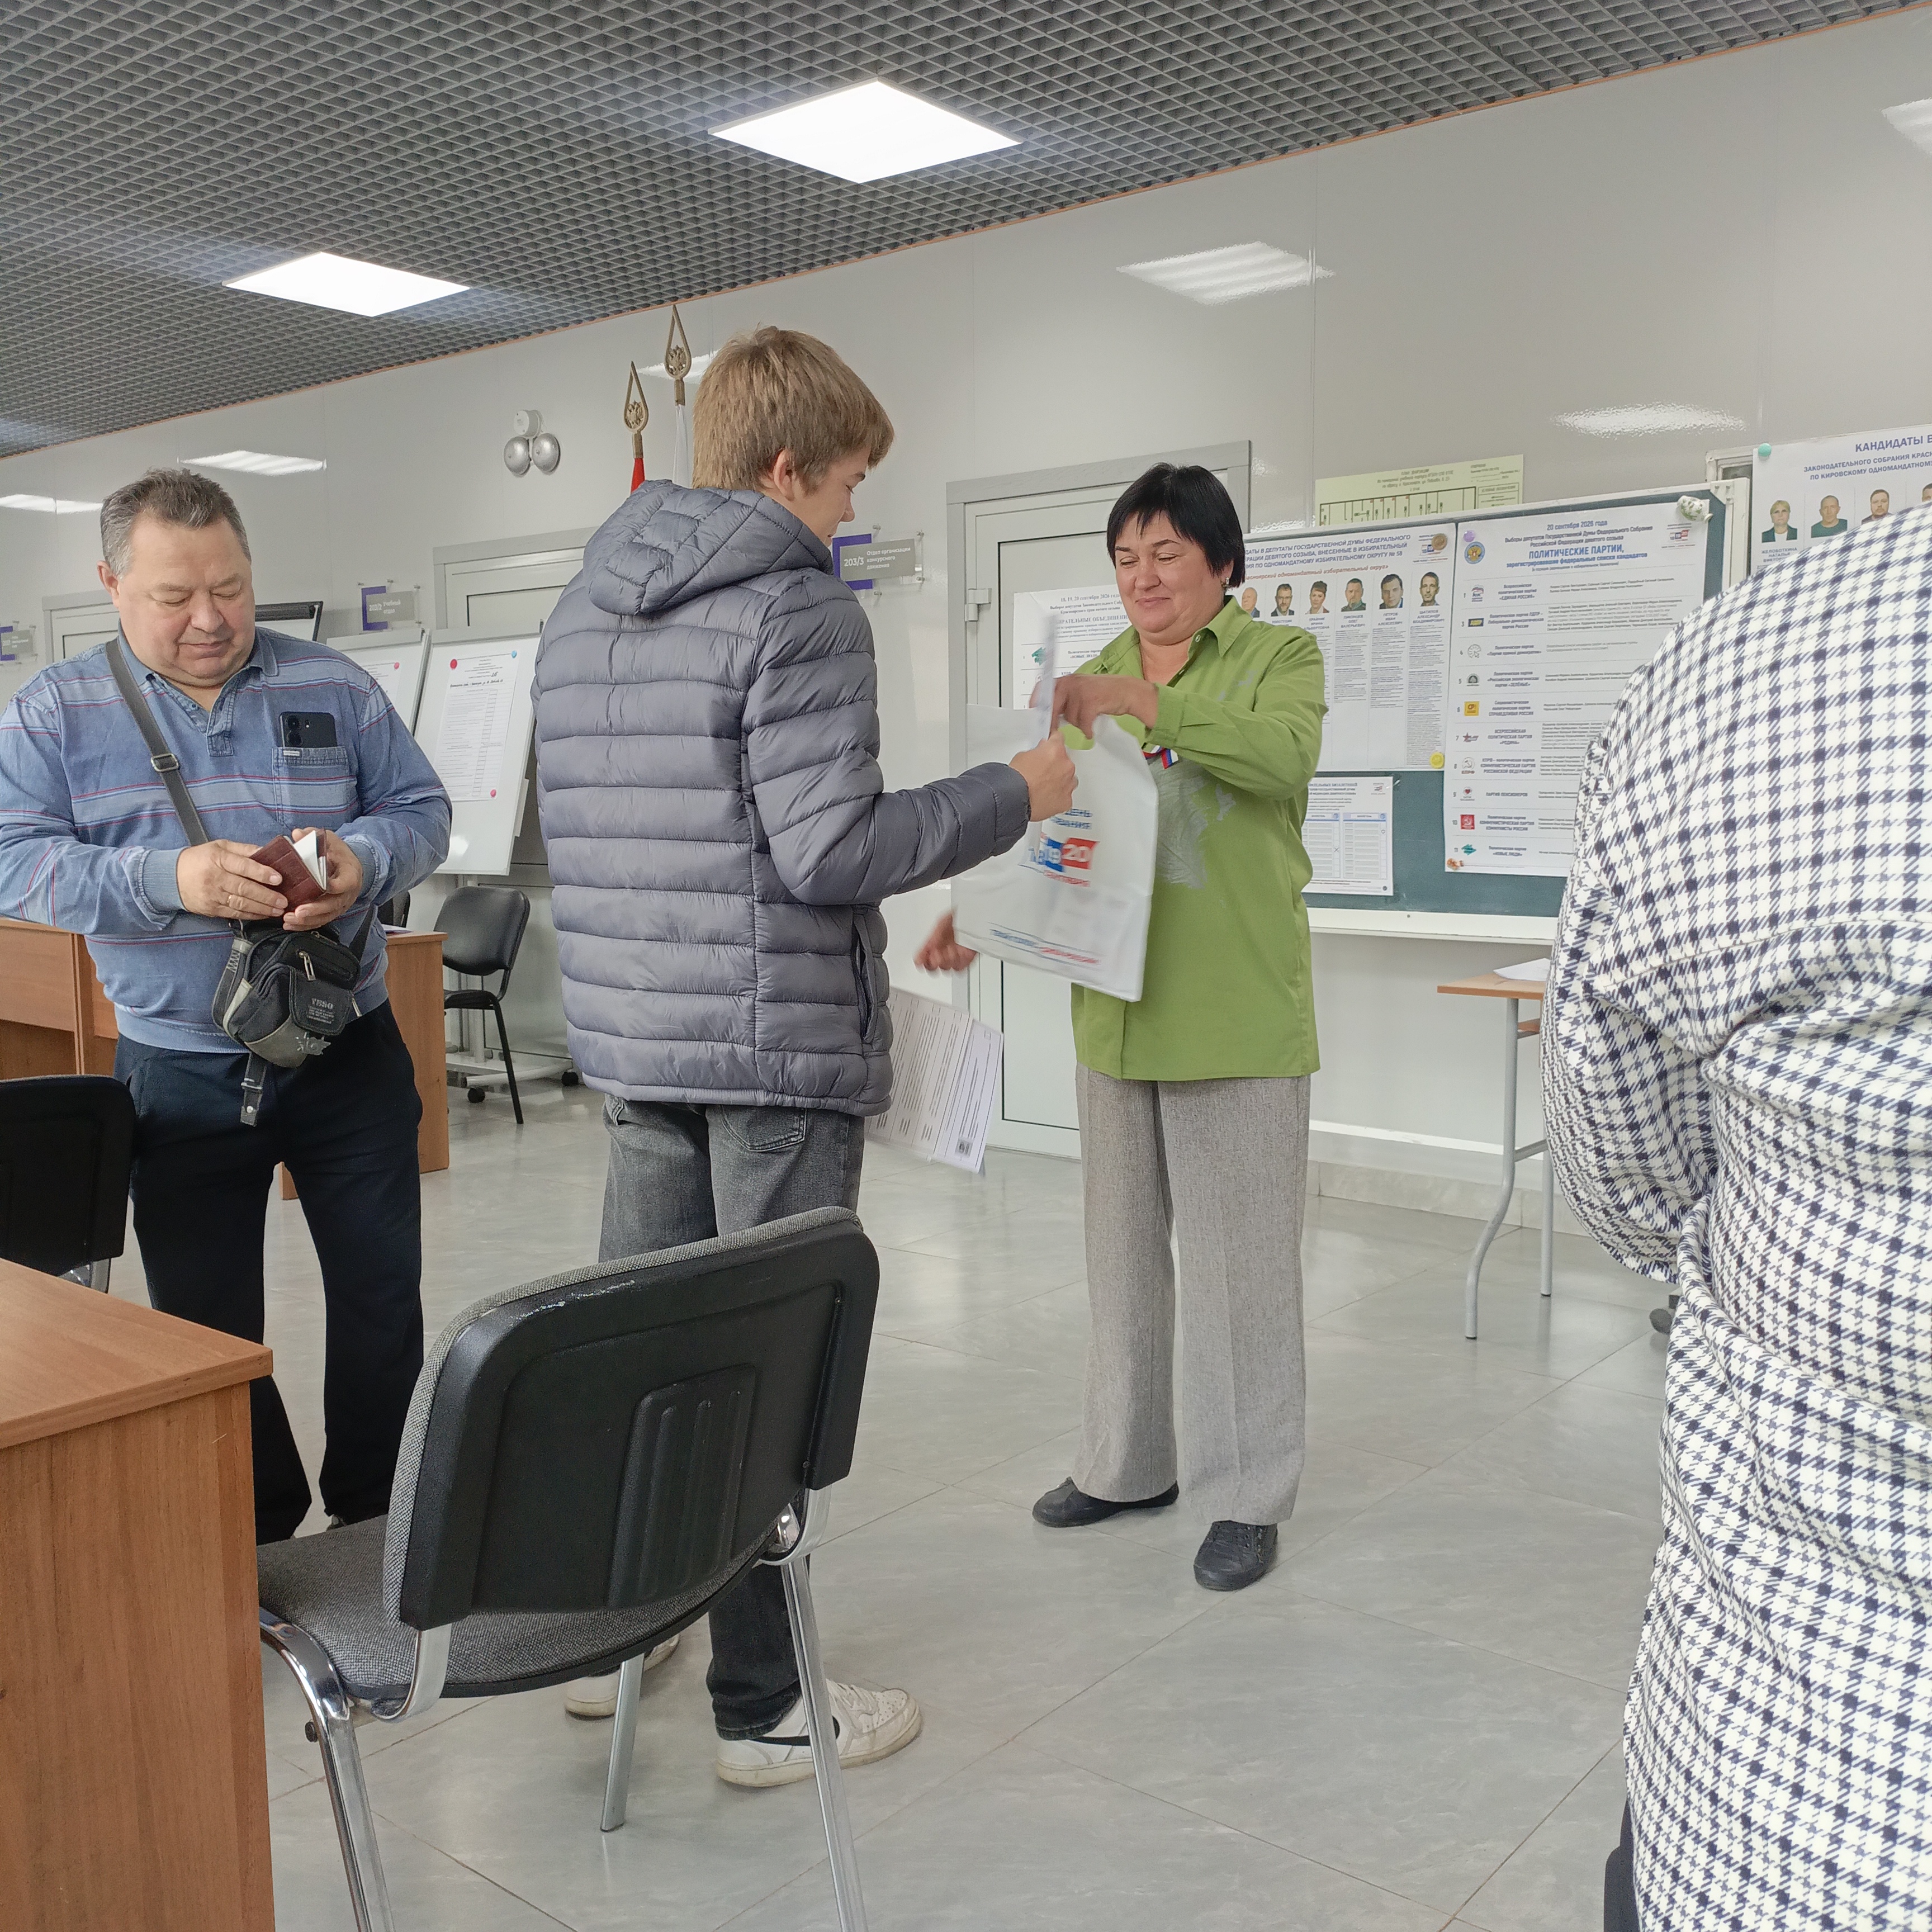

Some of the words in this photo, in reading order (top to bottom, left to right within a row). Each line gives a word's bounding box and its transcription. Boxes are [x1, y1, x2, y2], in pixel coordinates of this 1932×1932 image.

[1855, 435, 1923, 452] КАНДИДАТЫ
[1803, 458, 1871, 472] ЗАКОНОДАТЕЛЬНОГО
[1873, 454, 1910, 464] СОБРАНИЯ
[1821, 468, 1867, 479] КИРОВСКОМУ
[1868, 461, 1932, 473] ОДНОМАНДАТНОМ
[1265, 545, 1293, 553] ДЕПУТАТЫ
[1294, 540, 1347, 550] ГОСУДАРСТВЕННОЙ
[1365, 534, 1410, 543] ФЕДЕРАЛЬНОГО
[1318, 547, 1352, 556] ВНЕСЕННЫЕ
[1358, 543, 1407, 552] ИЗБИРАТЕЛЬНЫЙ
[1529, 547, 1589, 559] ПОЛИТИЧЕСКИЕ
[1591, 544, 1624, 554] ПАРТИИ,
[844, 556, 864, 567] 203/3
[1264, 559, 1314, 567] ОДНОМАНДАТНОМУ
[1315, 554, 1366, 563] ИЗБИРАТЕЛЬНОМУ
[1063, 844, 1091, 863] 20
